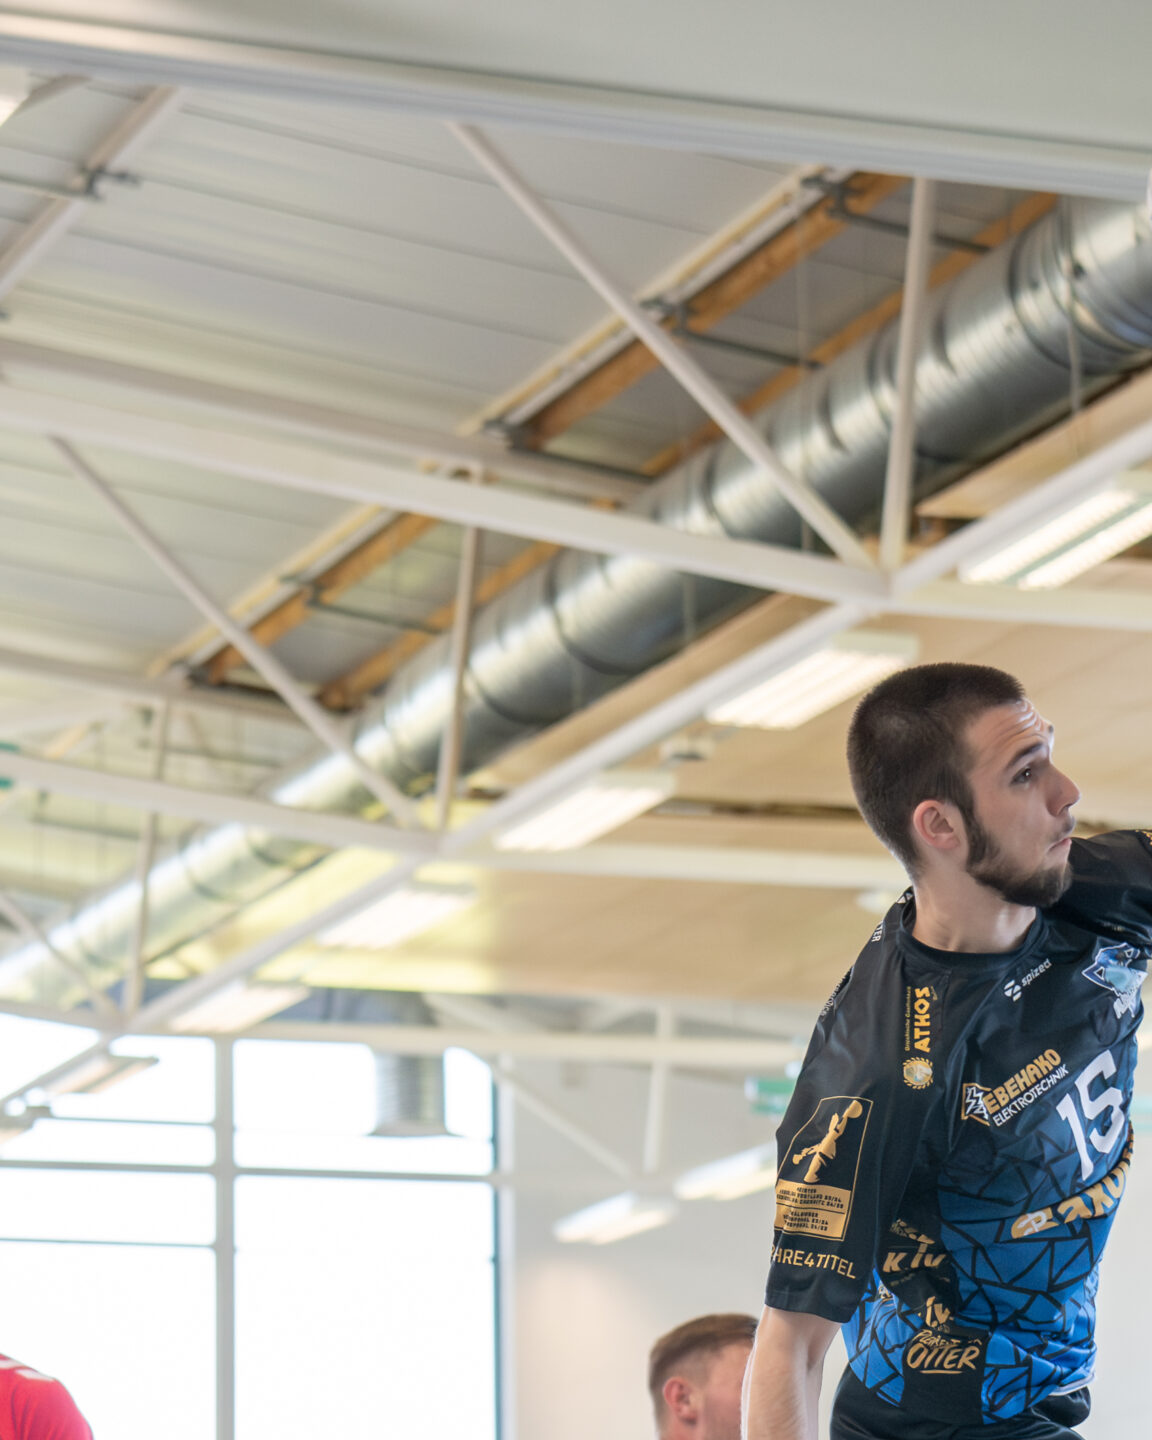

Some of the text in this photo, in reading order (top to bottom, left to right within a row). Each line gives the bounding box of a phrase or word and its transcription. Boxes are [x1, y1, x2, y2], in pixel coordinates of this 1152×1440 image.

[1020, 958, 1052, 987] spized
[914, 985, 932, 1053] ATHOS
[982, 1048, 1062, 1115] EBEHAKO
[992, 1063, 1070, 1128] ELEKTROTECHNIK
[1056, 1049, 1126, 1182] 15
[907, 1342, 981, 1370] OTTER
